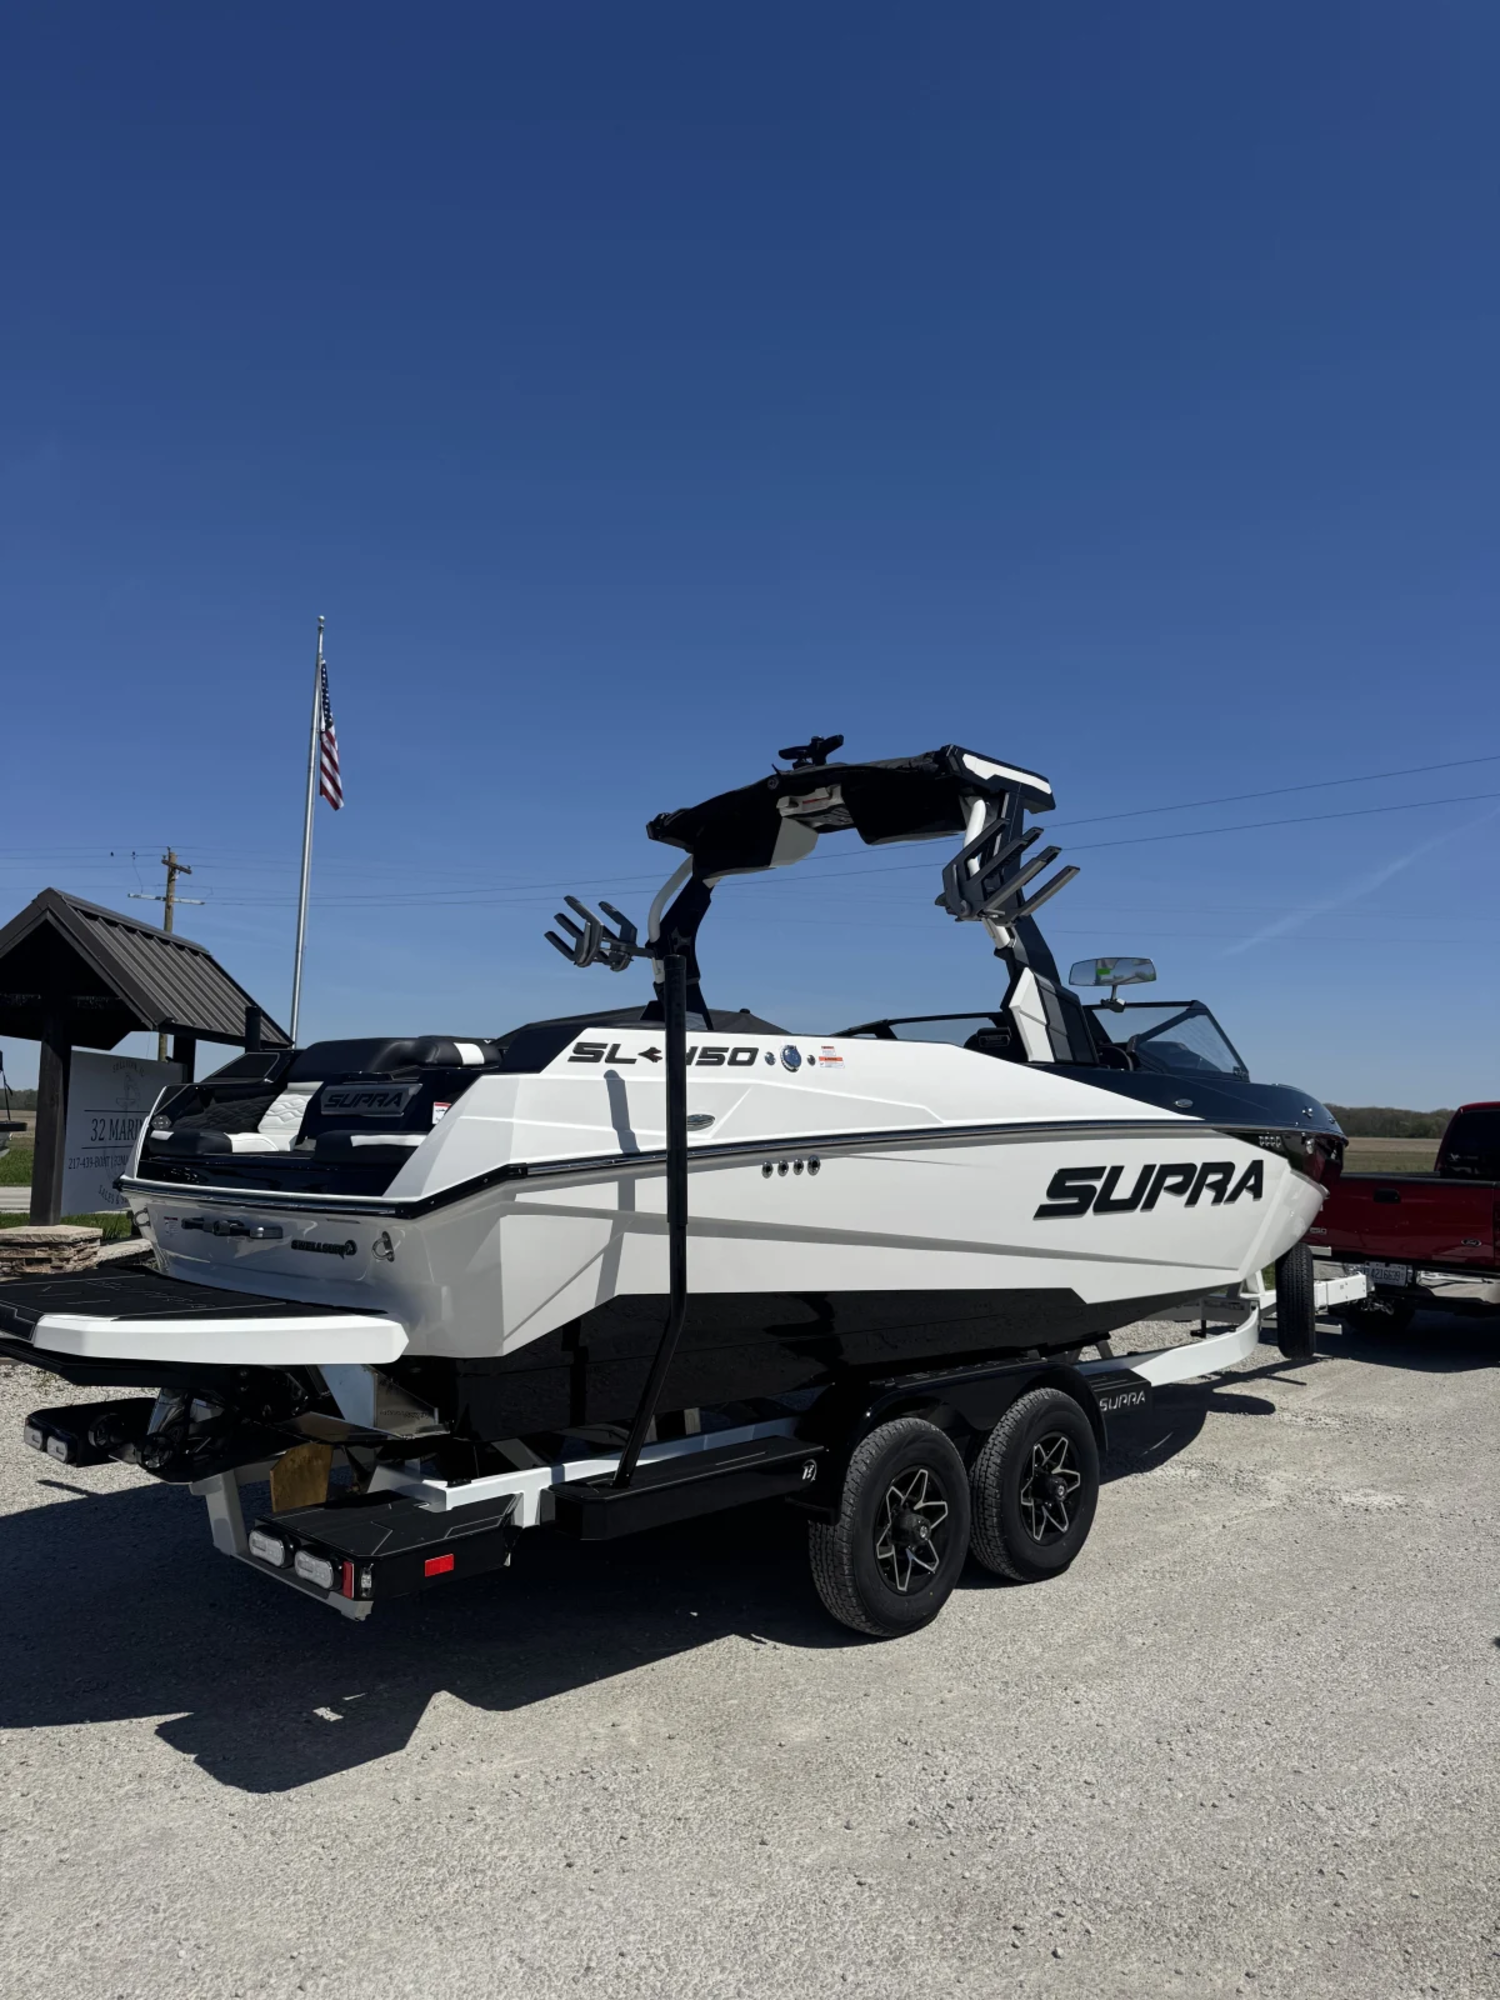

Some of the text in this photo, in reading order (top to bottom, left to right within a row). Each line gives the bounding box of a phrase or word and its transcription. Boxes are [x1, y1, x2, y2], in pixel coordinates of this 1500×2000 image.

[567, 1041, 638, 1065] SL
[324, 1092, 404, 1109] SUPRA
[90, 1118, 106, 1141] 32
[1032, 1159, 1265, 1221] SUPRA
[1099, 1390, 1146, 1411] SUPRA
